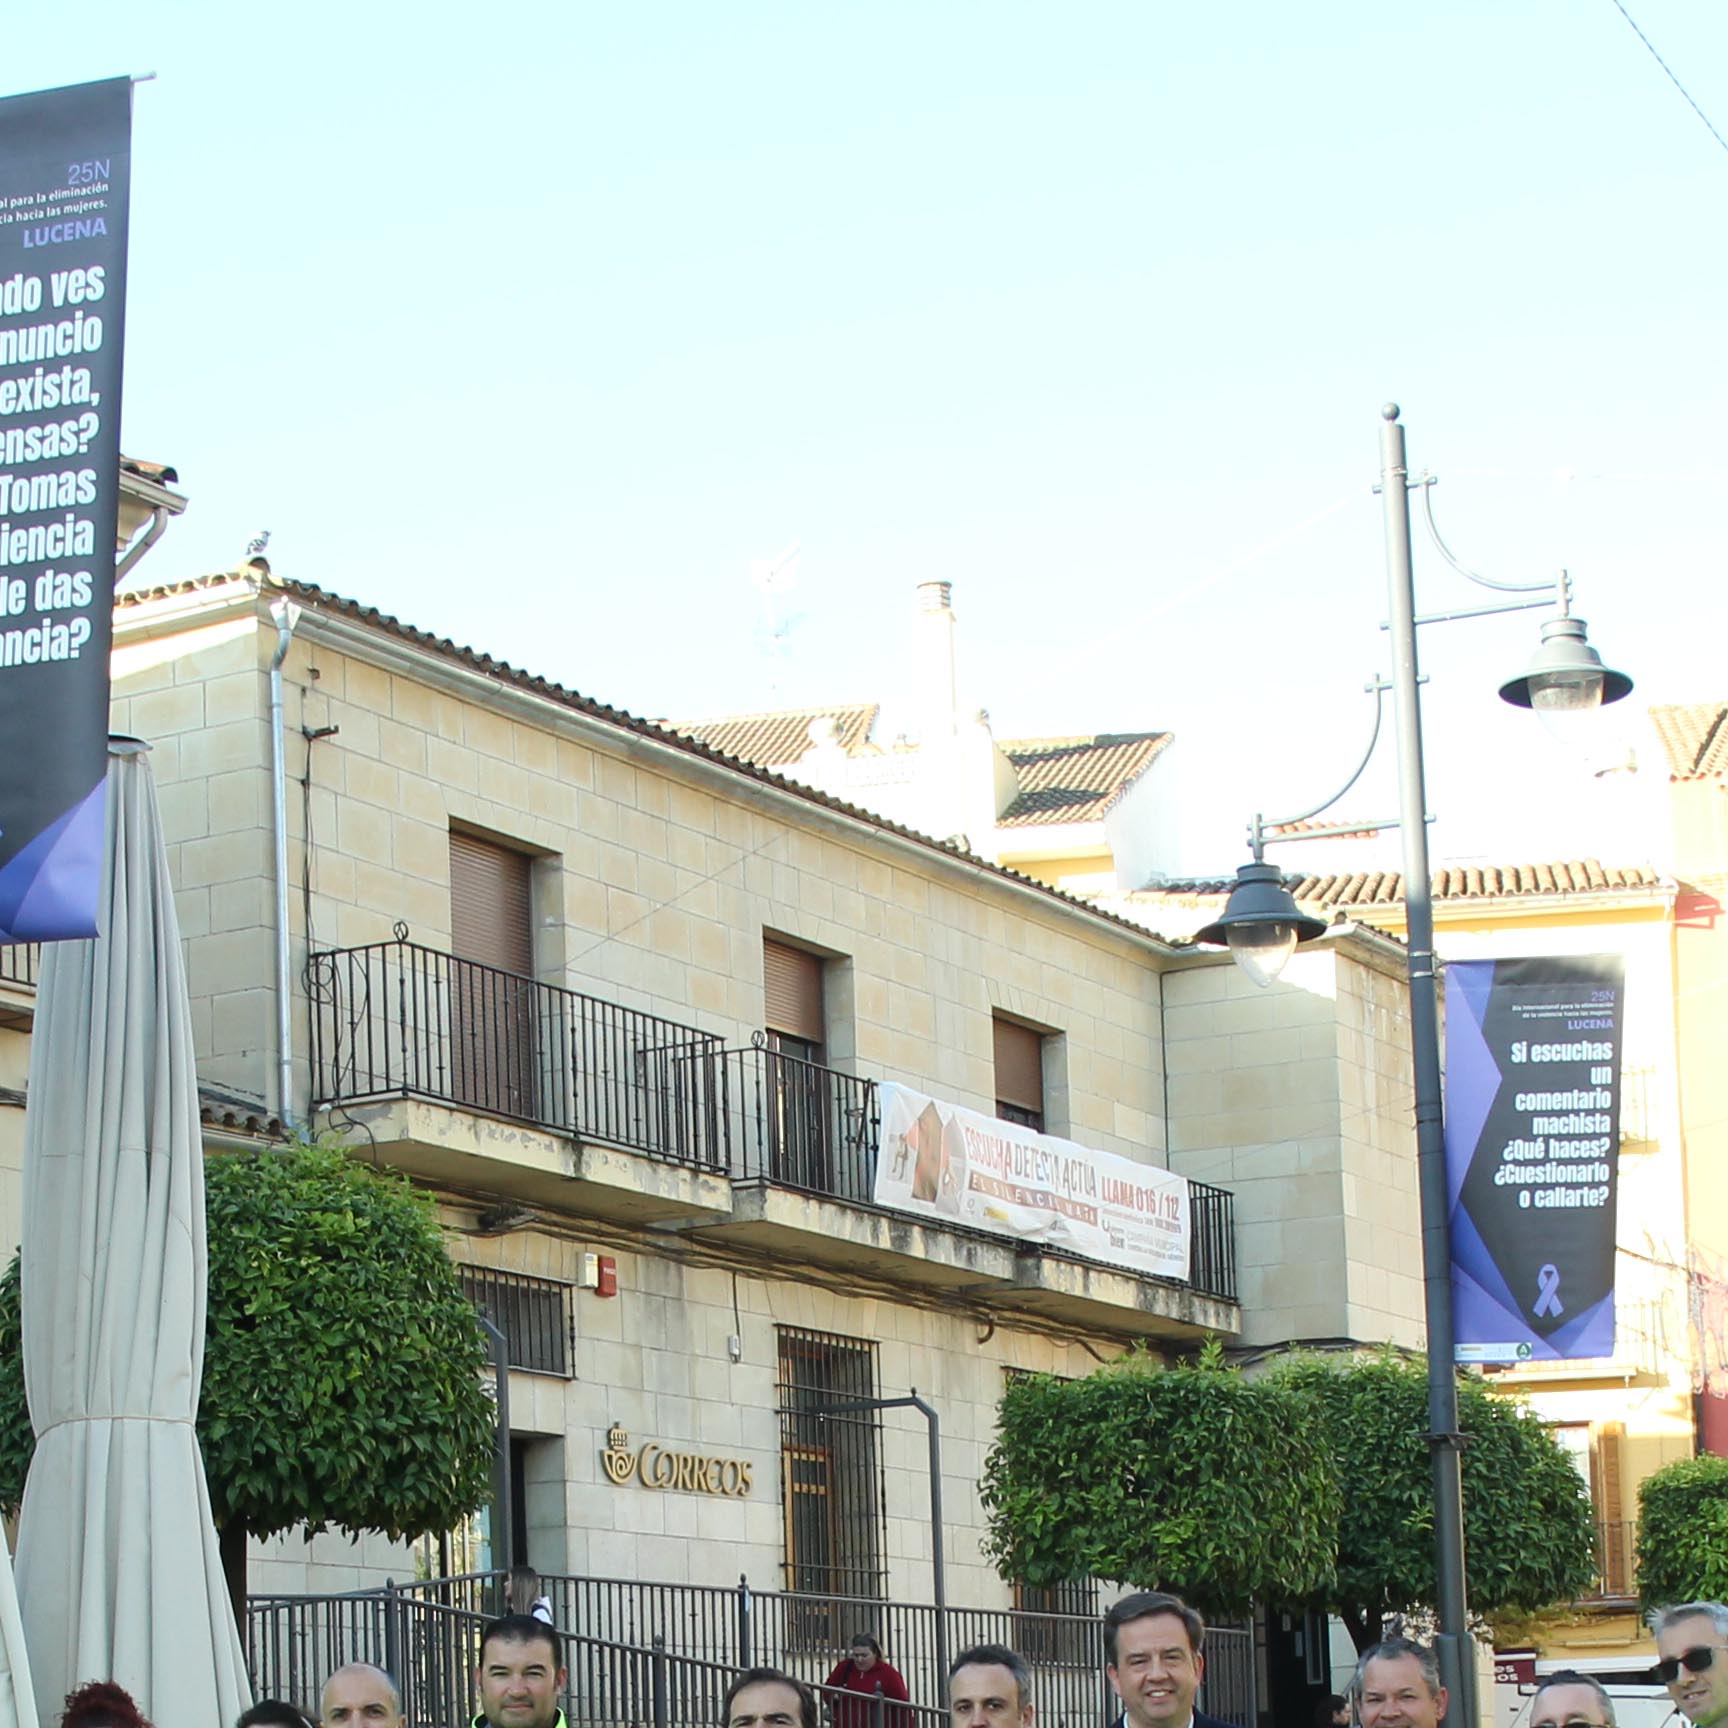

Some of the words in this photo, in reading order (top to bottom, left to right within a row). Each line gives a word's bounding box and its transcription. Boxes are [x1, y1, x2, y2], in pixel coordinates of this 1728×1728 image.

[68, 159, 110, 185] 25N
[10, 194, 34, 209] para
[37, 193, 47, 204] la
[49, 181, 109, 202] eliminación
[16, 208, 44, 221] hacia
[47, 205, 61, 217] las
[63, 199, 108, 215] mujeres.
[23, 217, 107, 248] LUCENA
[50, 265, 106, 308] ves
[34, 568, 94, 609] das
[1592, 991, 1614, 1001] 25N
[1568, 1019, 1613, 1030] LUCENA
[1511, 1041, 1527, 1063] Si
[1530, 1040, 1613, 1062] escuchas
[1590, 1066, 1612, 1085] un
[1515, 1087, 1611, 1112] comentario
[1532, 1112, 1611, 1135] machista
[1503, 1137, 1545, 1161] ¿Qué
[1549, 1137, 1610, 1159] haces?
[965, 1126, 1012, 1180] ESCUCHA
[1014, 1143, 1060, 1193] DETECTA
[1101, 1175, 1134, 1209] LLAMA
[1136, 1186, 1156, 1215] 016
[1165, 1194, 1180, 1221] 112
[1494, 1162, 1610, 1186] ¿Cuestionarlo
[1519, 1190, 1530, 1208] o
[1534, 1186, 1609, 1208] callarte?
